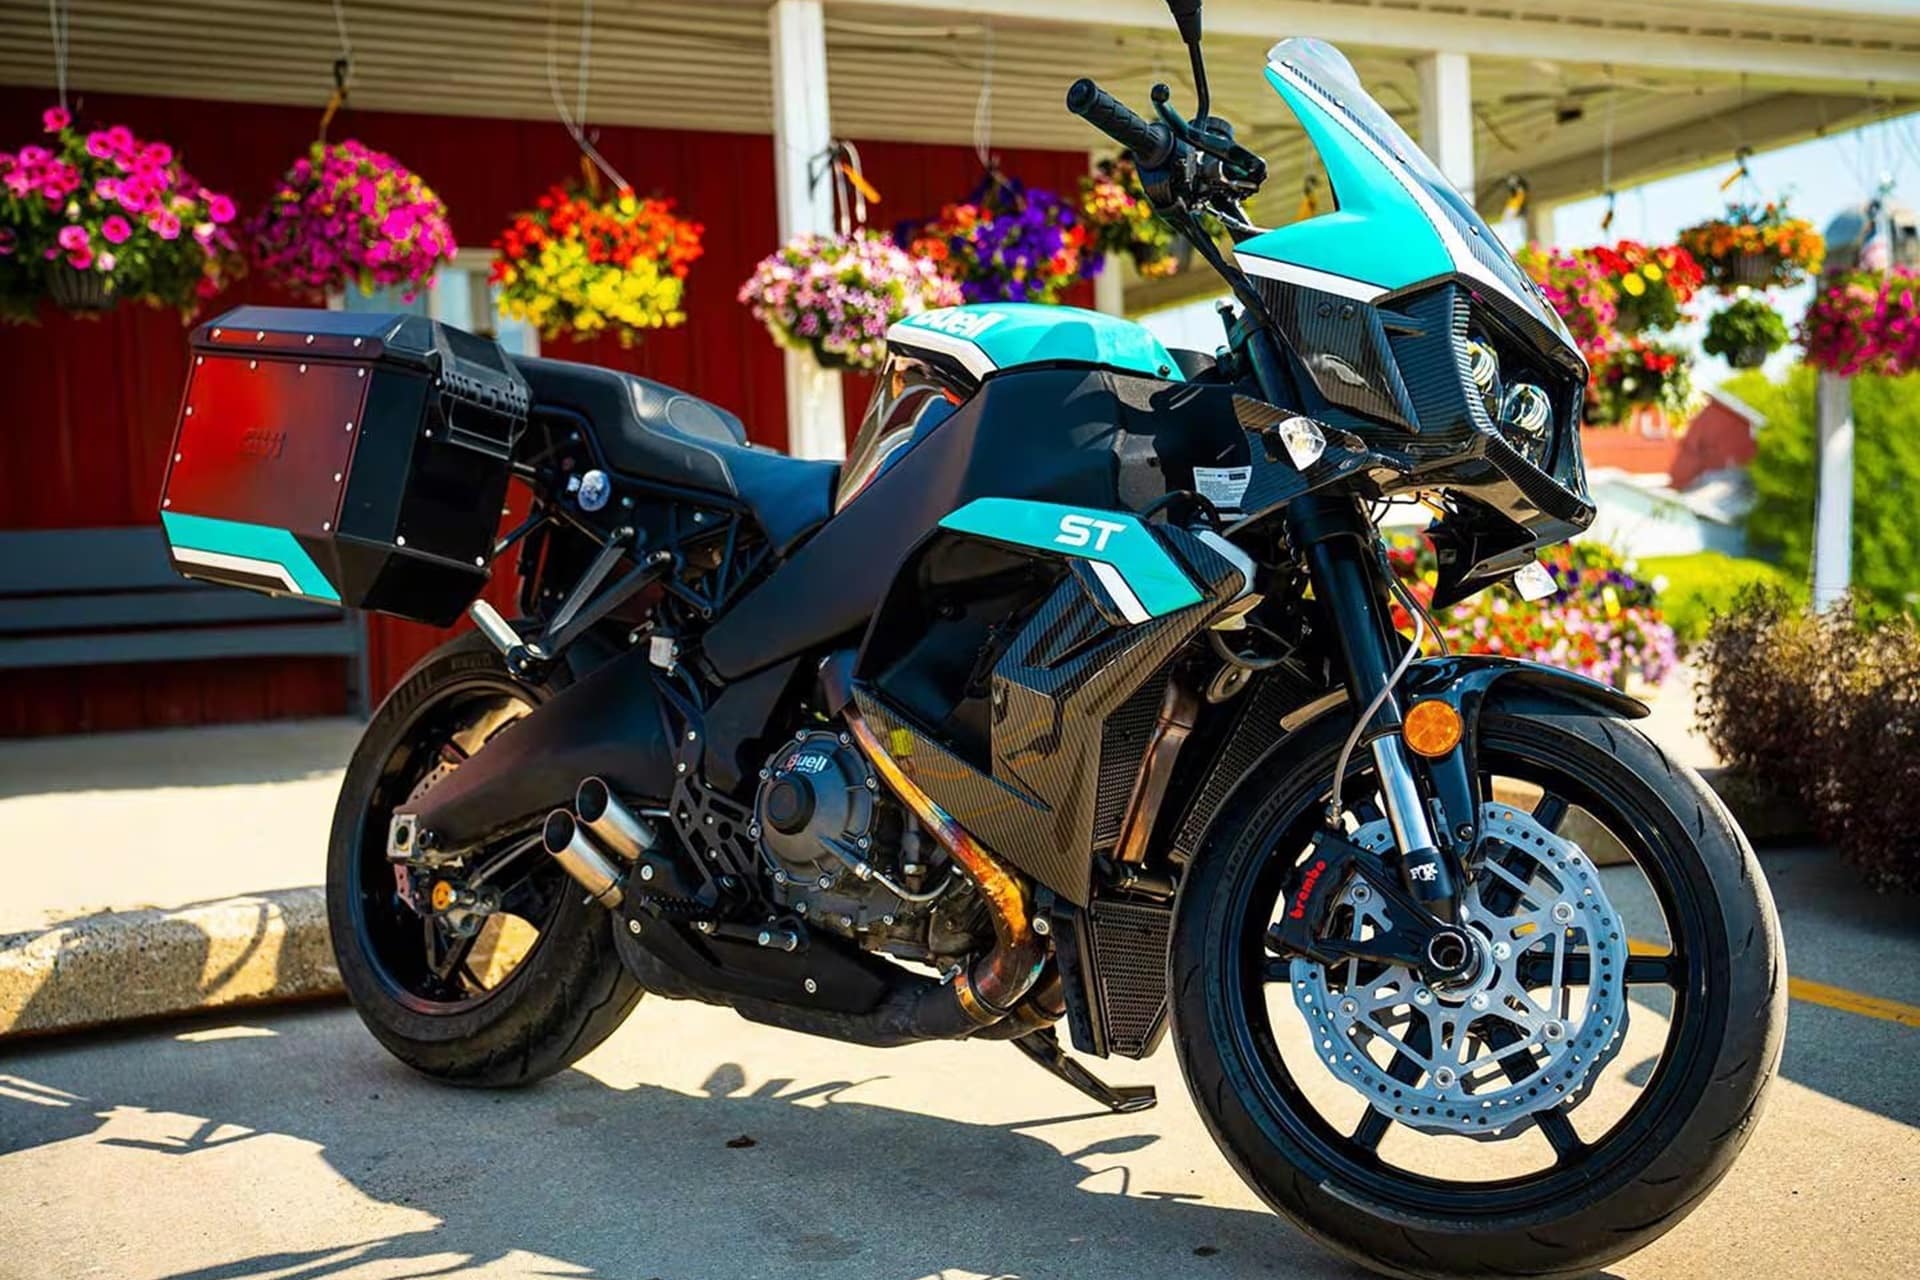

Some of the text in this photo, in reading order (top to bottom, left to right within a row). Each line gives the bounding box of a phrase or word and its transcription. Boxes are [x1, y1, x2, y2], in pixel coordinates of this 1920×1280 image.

[1053, 513, 1128, 552] ST
[1289, 860, 1326, 919] brembo
[1409, 862, 1439, 881] FOX
